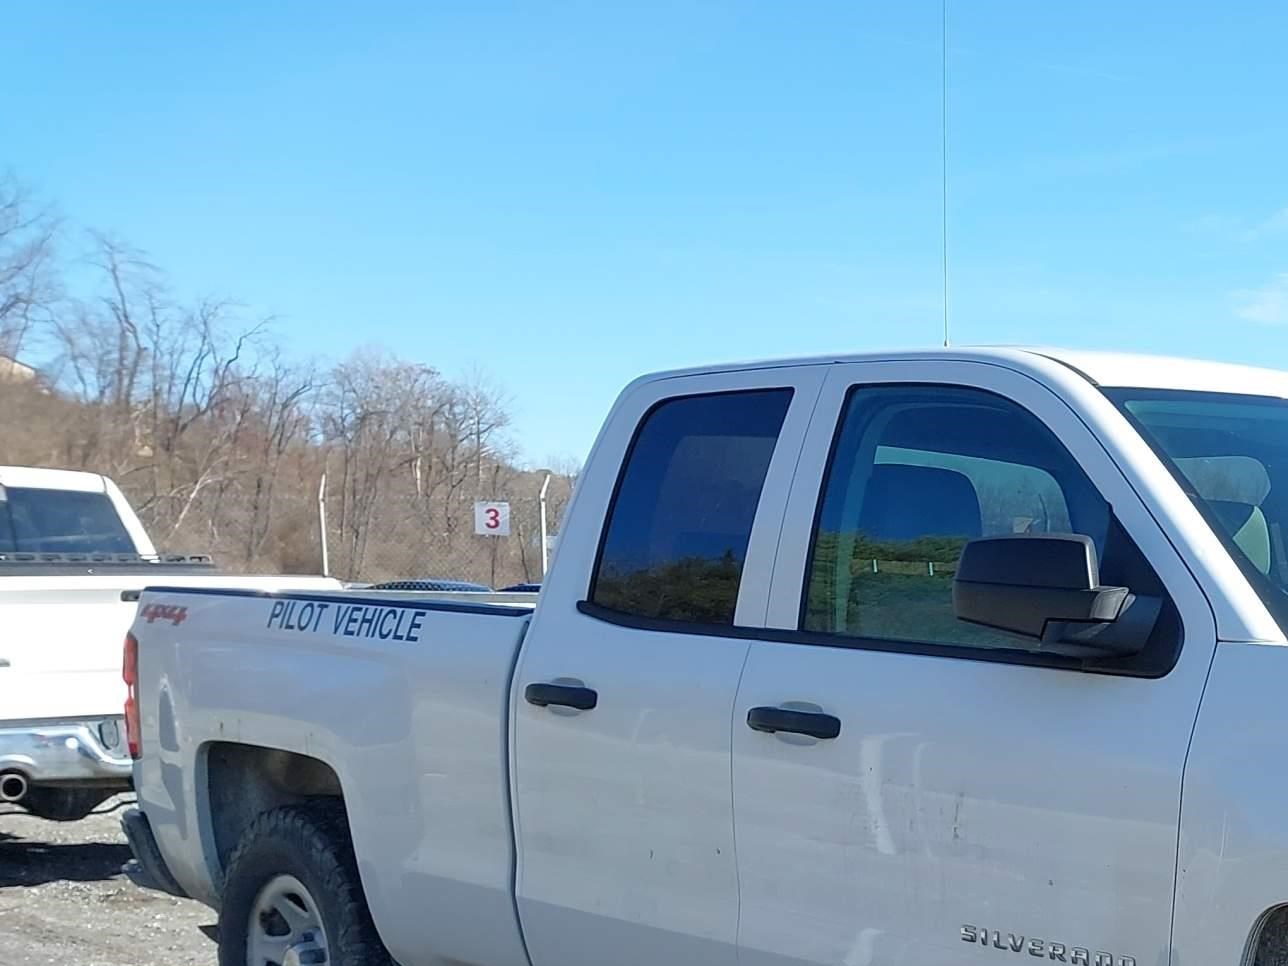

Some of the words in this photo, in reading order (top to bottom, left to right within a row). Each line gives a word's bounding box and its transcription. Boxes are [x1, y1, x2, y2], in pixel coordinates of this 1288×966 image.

[485, 508, 500, 529] 3
[267, 601, 329, 633] PILOT
[332, 605, 427, 642] VEHICLE
